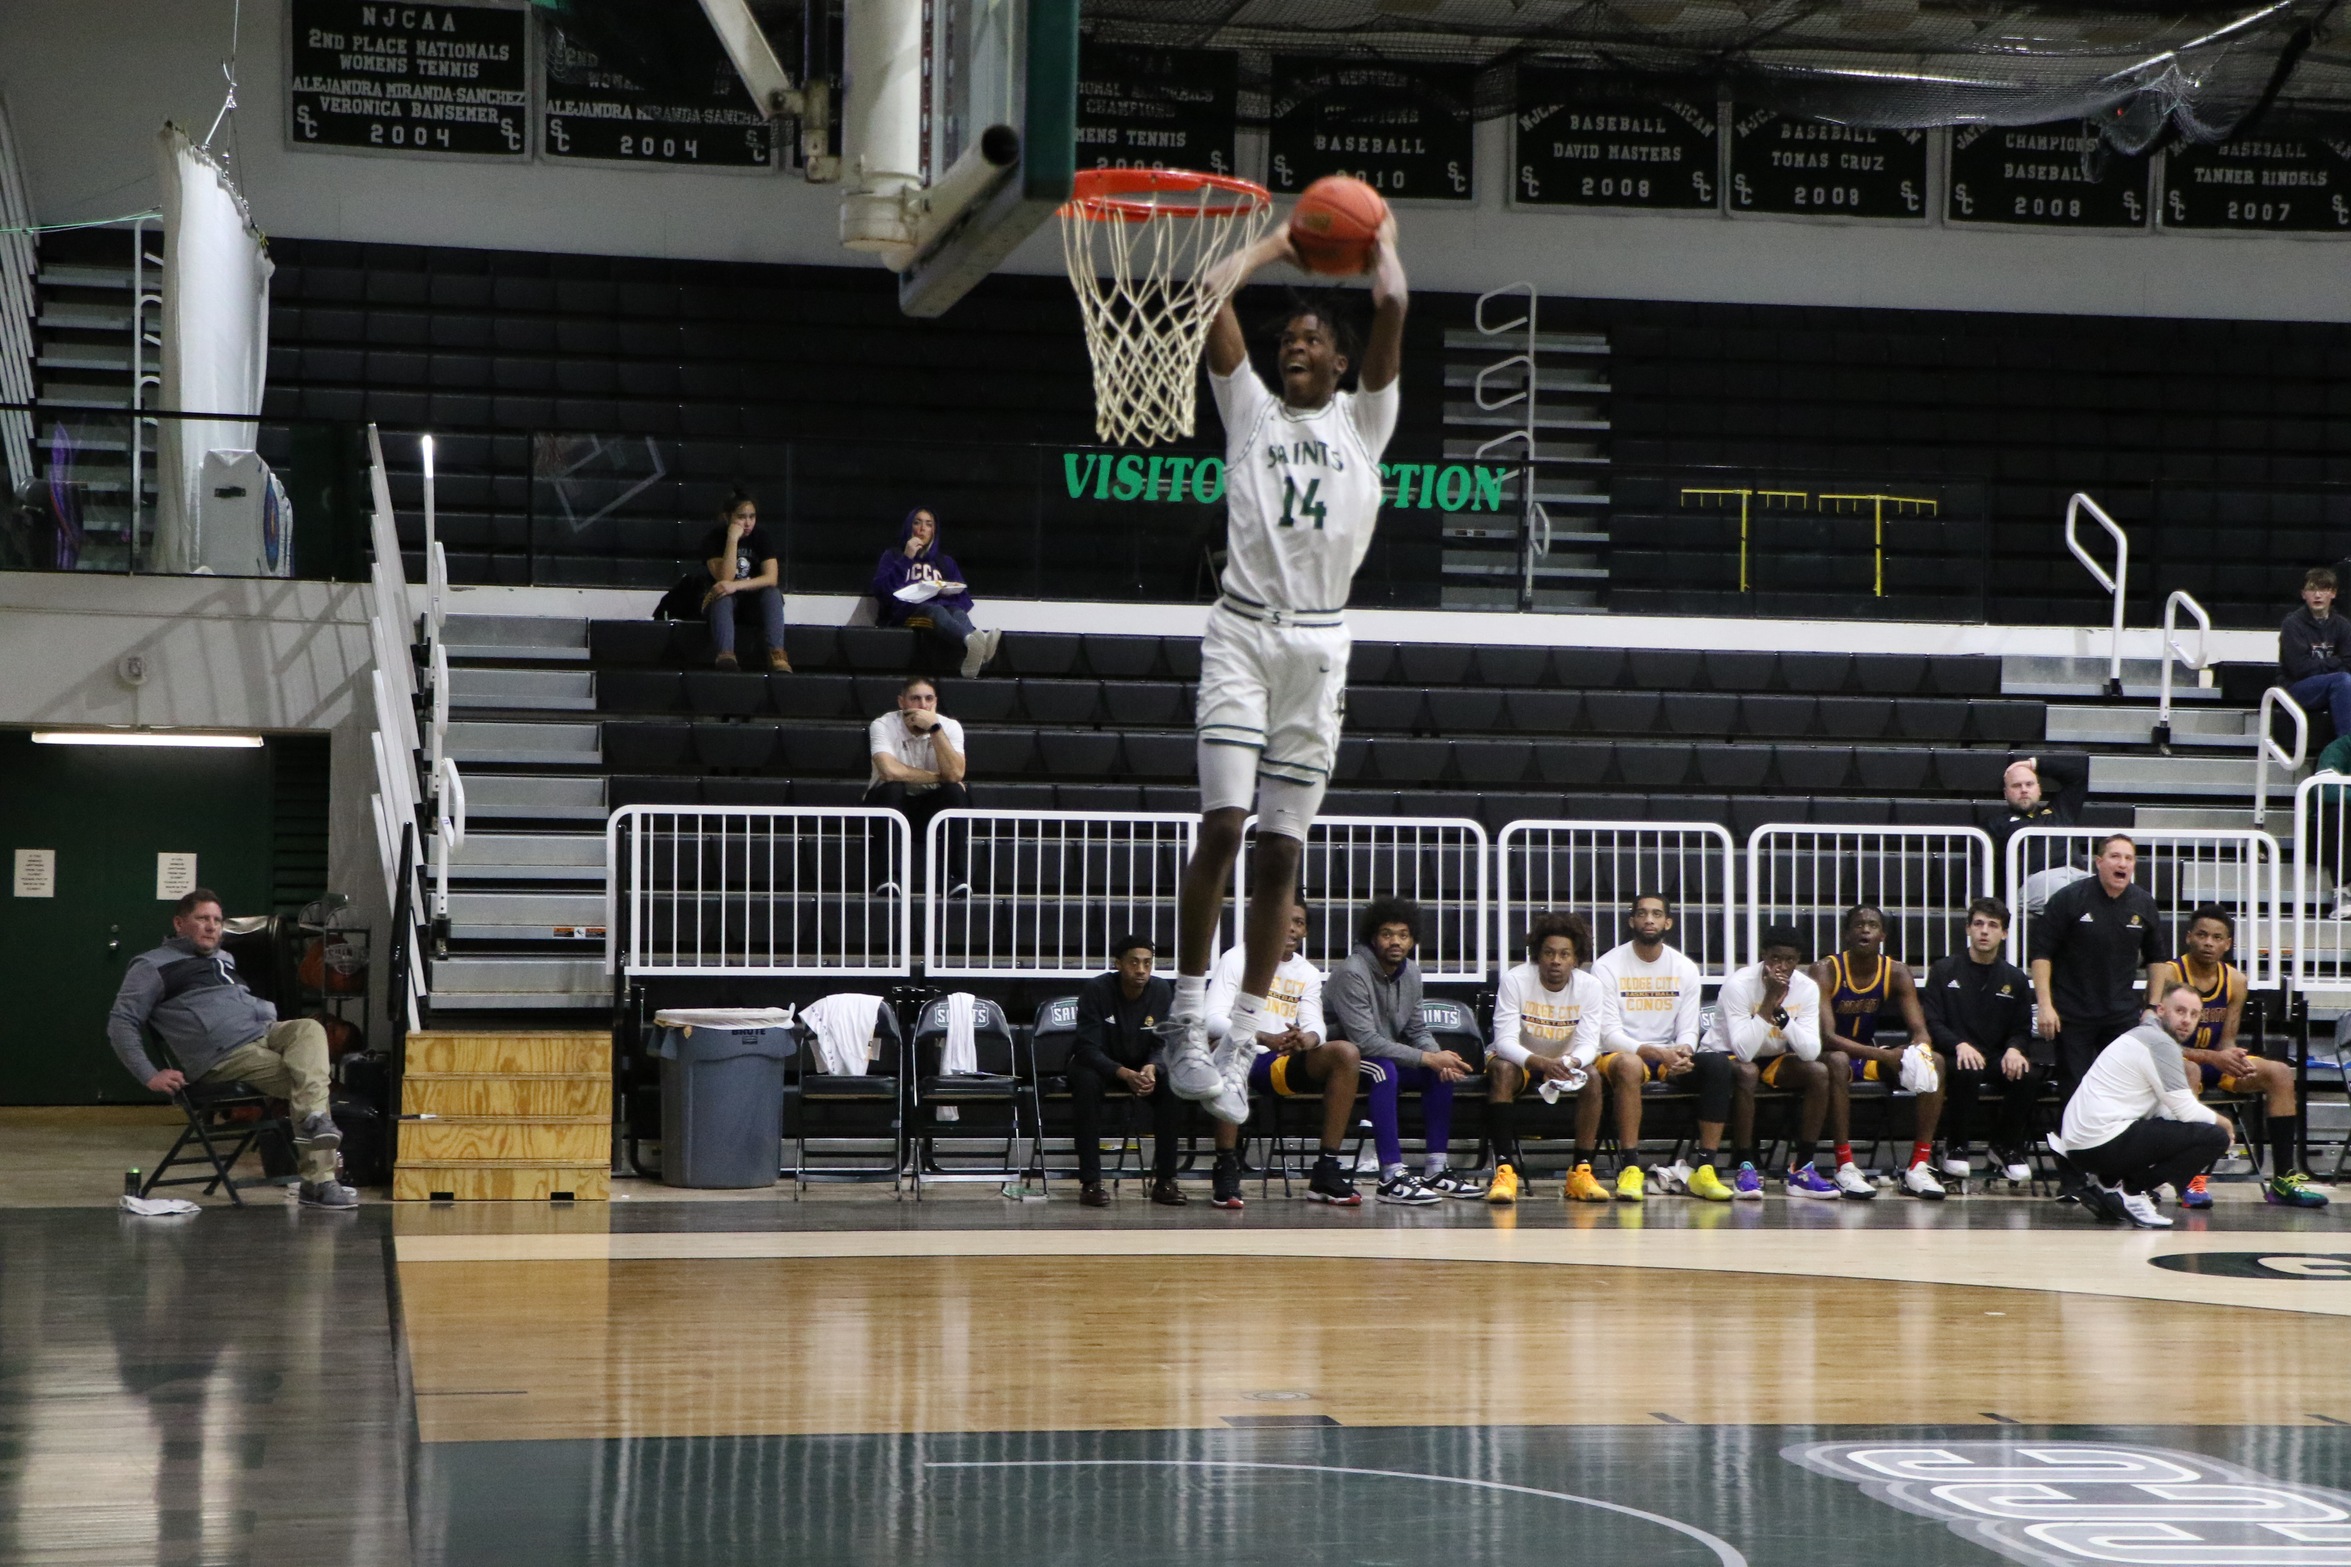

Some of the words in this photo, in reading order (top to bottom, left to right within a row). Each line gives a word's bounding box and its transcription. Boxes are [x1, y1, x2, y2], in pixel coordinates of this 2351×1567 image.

[362, 6, 455, 32] NJCAA
[308, 28, 345, 50] 2ND
[352, 35, 408, 54] PLACE
[416, 39, 510, 61] NATIONALS
[339, 54, 408, 74] WOMENS
[416, 60, 479, 78] TENNIS
[293, 76, 382, 97] ALEJANDRA
[1077, 82, 1121, 97] IONAL
[320, 96, 401, 117] VERONICA
[411, 101, 499, 124] BANSEMER
[546, 99, 632, 119] ALEJANDRA
[1569, 114, 1667, 134] BASEBALL
[1781, 123, 1877, 143] BASEBALL
[370, 124, 449, 147] 2004
[1072, 127, 1117, 144] MENS
[1126, 130, 1187, 147] TENNIS
[1314, 135, 1426, 155] BASEBALL
[2005, 133, 2097, 153] CHAMPIONS
[620, 135, 698, 158] 2004
[1553, 142, 1600, 160] DAVID
[1608, 144, 1682, 162] MASTERS
[1771, 151, 1829, 168] TOMAS
[1840, 154, 1885, 171] CRUZ
[2004, 163, 2093, 182] BASEBALL
[2194, 167, 2255, 185] TANNER
[1581, 176, 1650, 198] 2008
[1794, 186, 1859, 206] 2008
[2014, 196, 2081, 218] 2008
[2227, 201, 2291, 222] 2007
[1267, 440, 1344, 473] SAINTS
[1063, 453, 1226, 504] VISITO
[1378, 463, 1506, 512] TION
[1278, 475, 1327, 530] 14
[1655, 976, 1680, 990] CITY
[1424, 1010, 1458, 1025] INTS
[2194, 1027, 2211, 1049] 10
